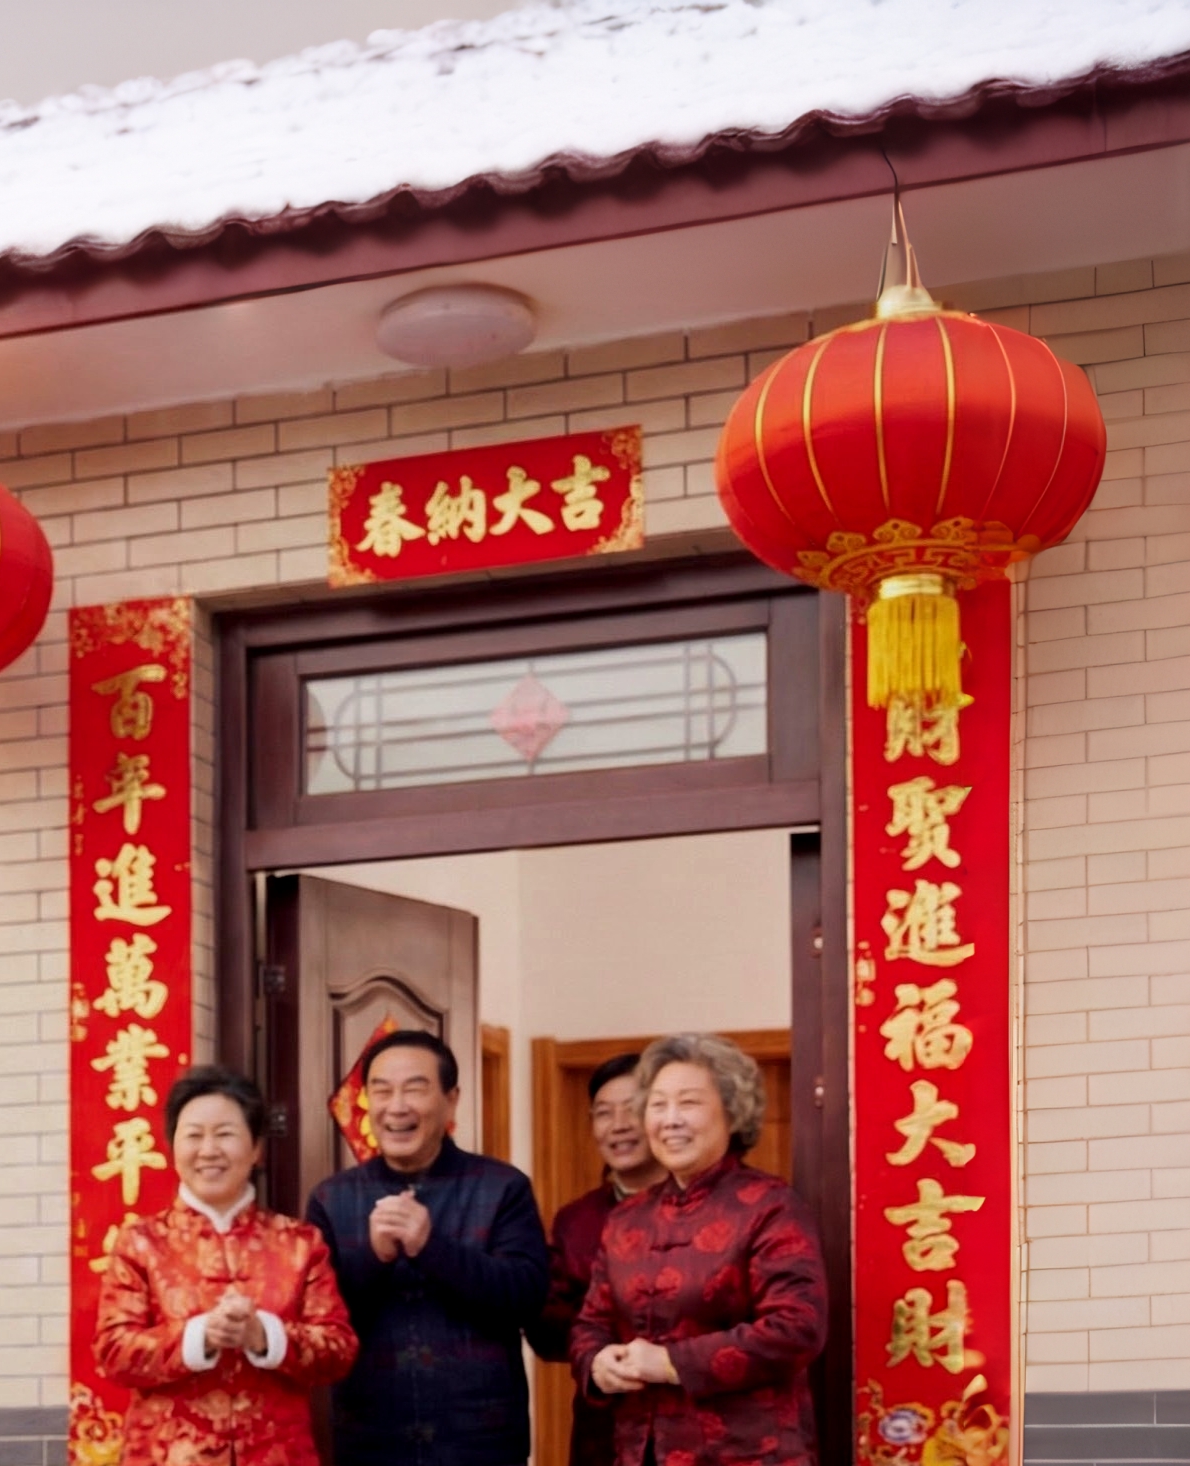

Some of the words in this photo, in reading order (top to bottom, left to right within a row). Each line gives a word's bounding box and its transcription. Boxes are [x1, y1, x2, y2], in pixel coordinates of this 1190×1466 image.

[355, 455, 610, 558] 春納大吉
[89, 663, 173, 1274] 百年進萬業平
